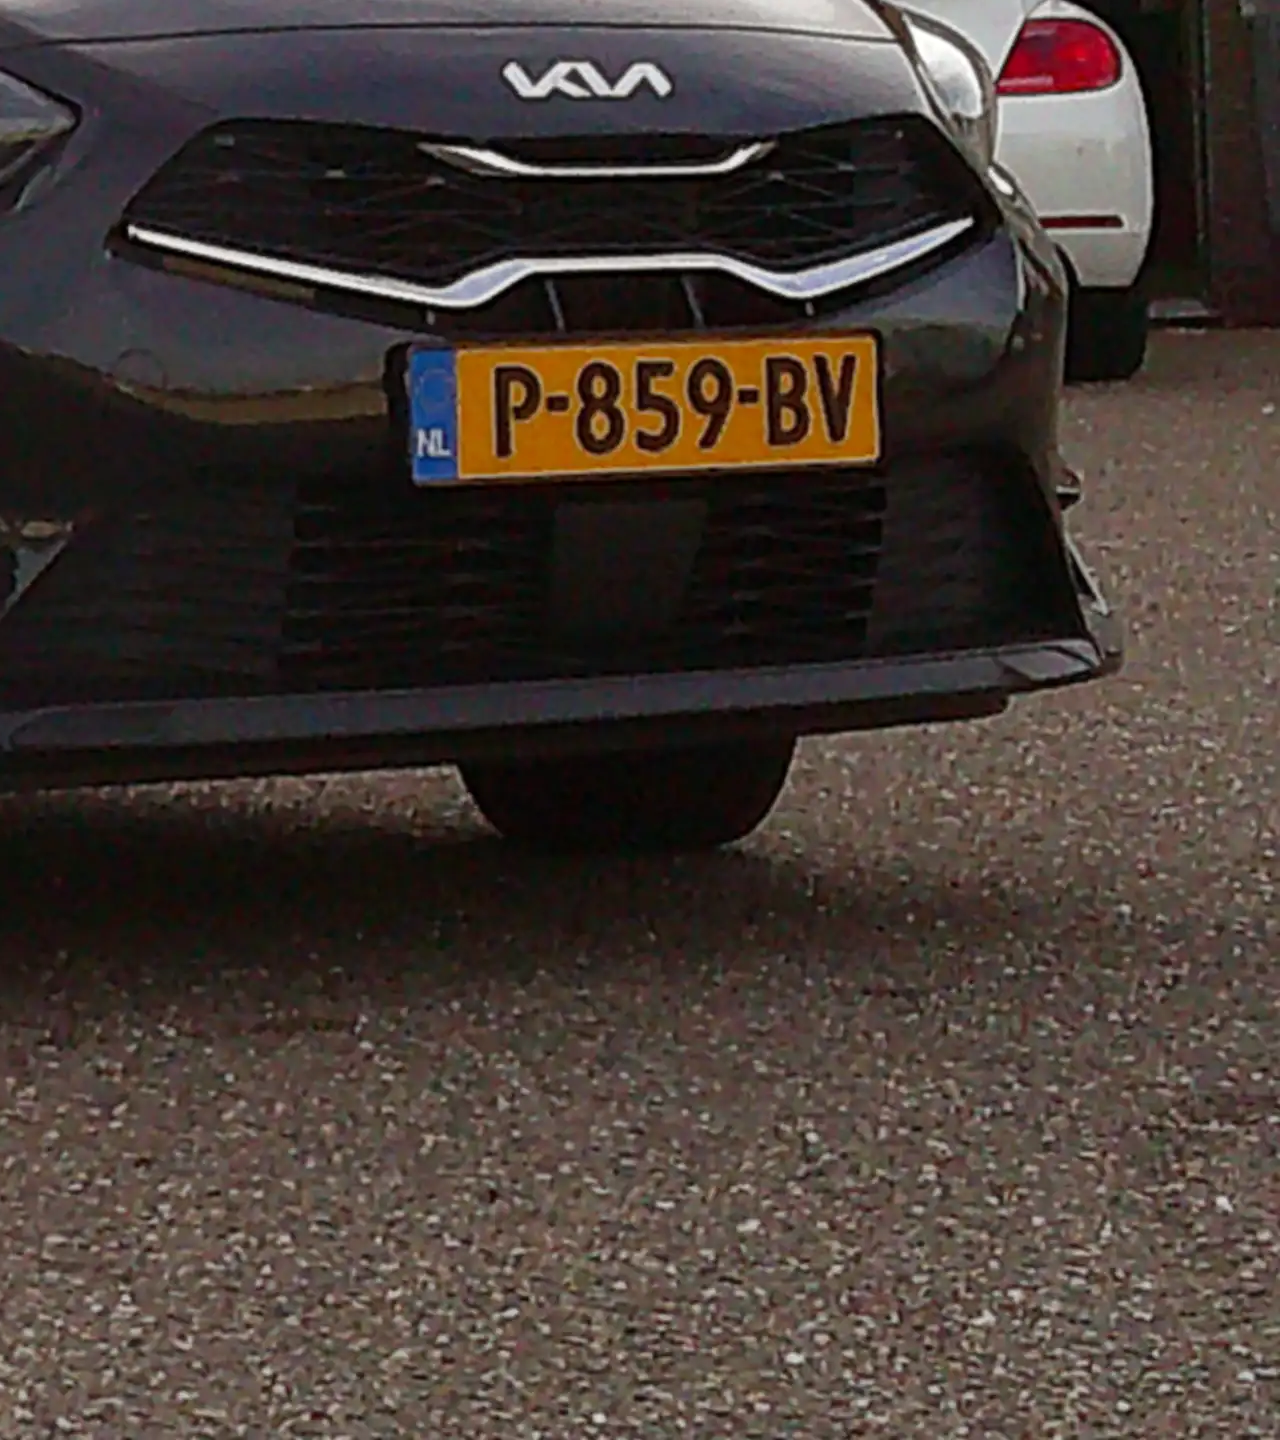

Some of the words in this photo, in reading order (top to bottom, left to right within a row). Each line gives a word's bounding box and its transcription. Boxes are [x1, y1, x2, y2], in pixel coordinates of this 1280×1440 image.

[501, 61, 673, 98] KIA
[416, 428, 452, 457] NL
[493, 354, 858, 458] P-859-BV
